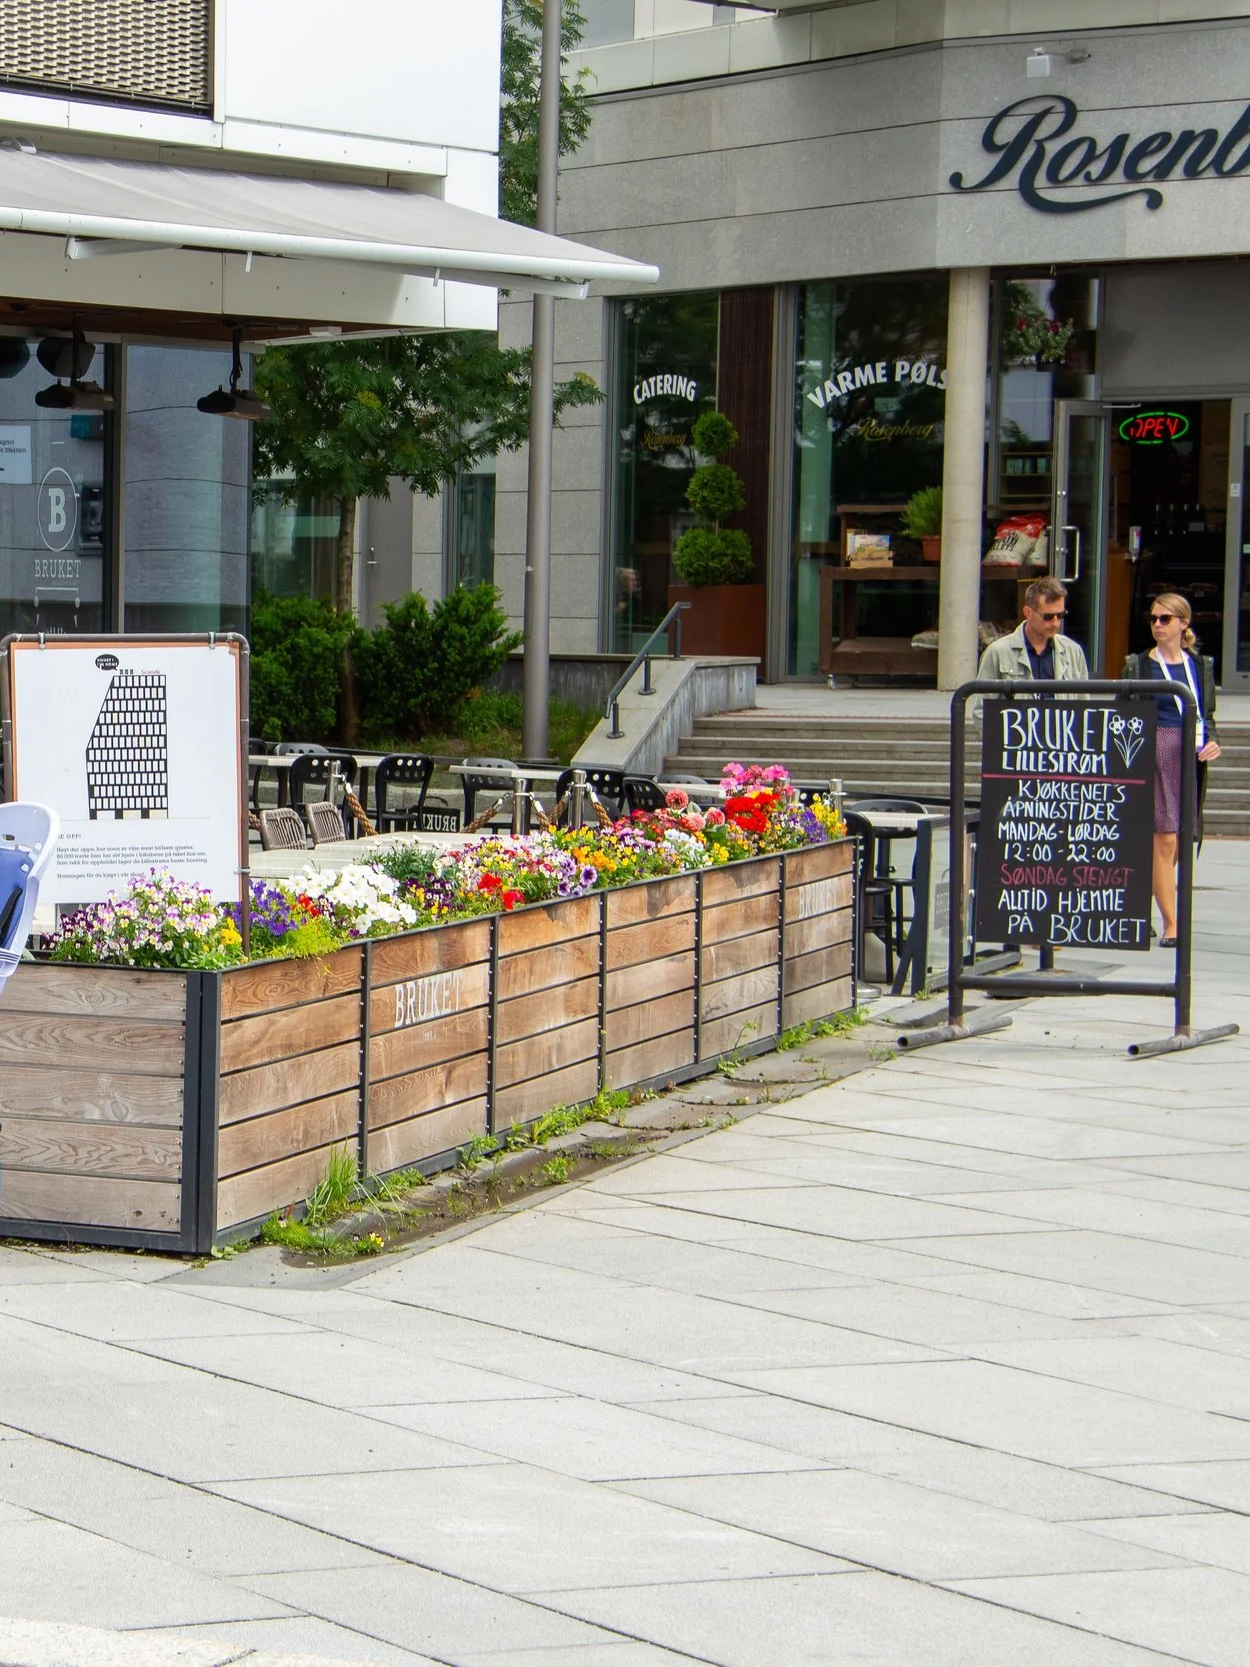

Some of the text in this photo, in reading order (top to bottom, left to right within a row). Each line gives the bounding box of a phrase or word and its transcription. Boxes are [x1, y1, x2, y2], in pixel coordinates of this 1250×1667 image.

[633, 374, 697, 405] CATERING
[806, 361, 887, 409] VARME
[855, 418, 934, 441] Rosenberg
[1130, 418, 1179, 438] OPEN
[48, 488, 66, 532] B
[34, 559, 81, 578] BRUKET
[1000, 707, 1116, 752] BRUKET
[1002, 750, 1107, 776] LILLESTRØM
[1004, 842, 1052, 861] 12:00
[1066, 844, 1116, 862] 22:00
[1000, 864, 1135, 886] SØNDAG STENGT
[798, 876, 838, 919] BRUKET
[998, 887, 1047, 911] ALLTID
[1008, 912, 1146, 944] PÅ BRUKET
[394, 971, 463, 1028] BRUKET
